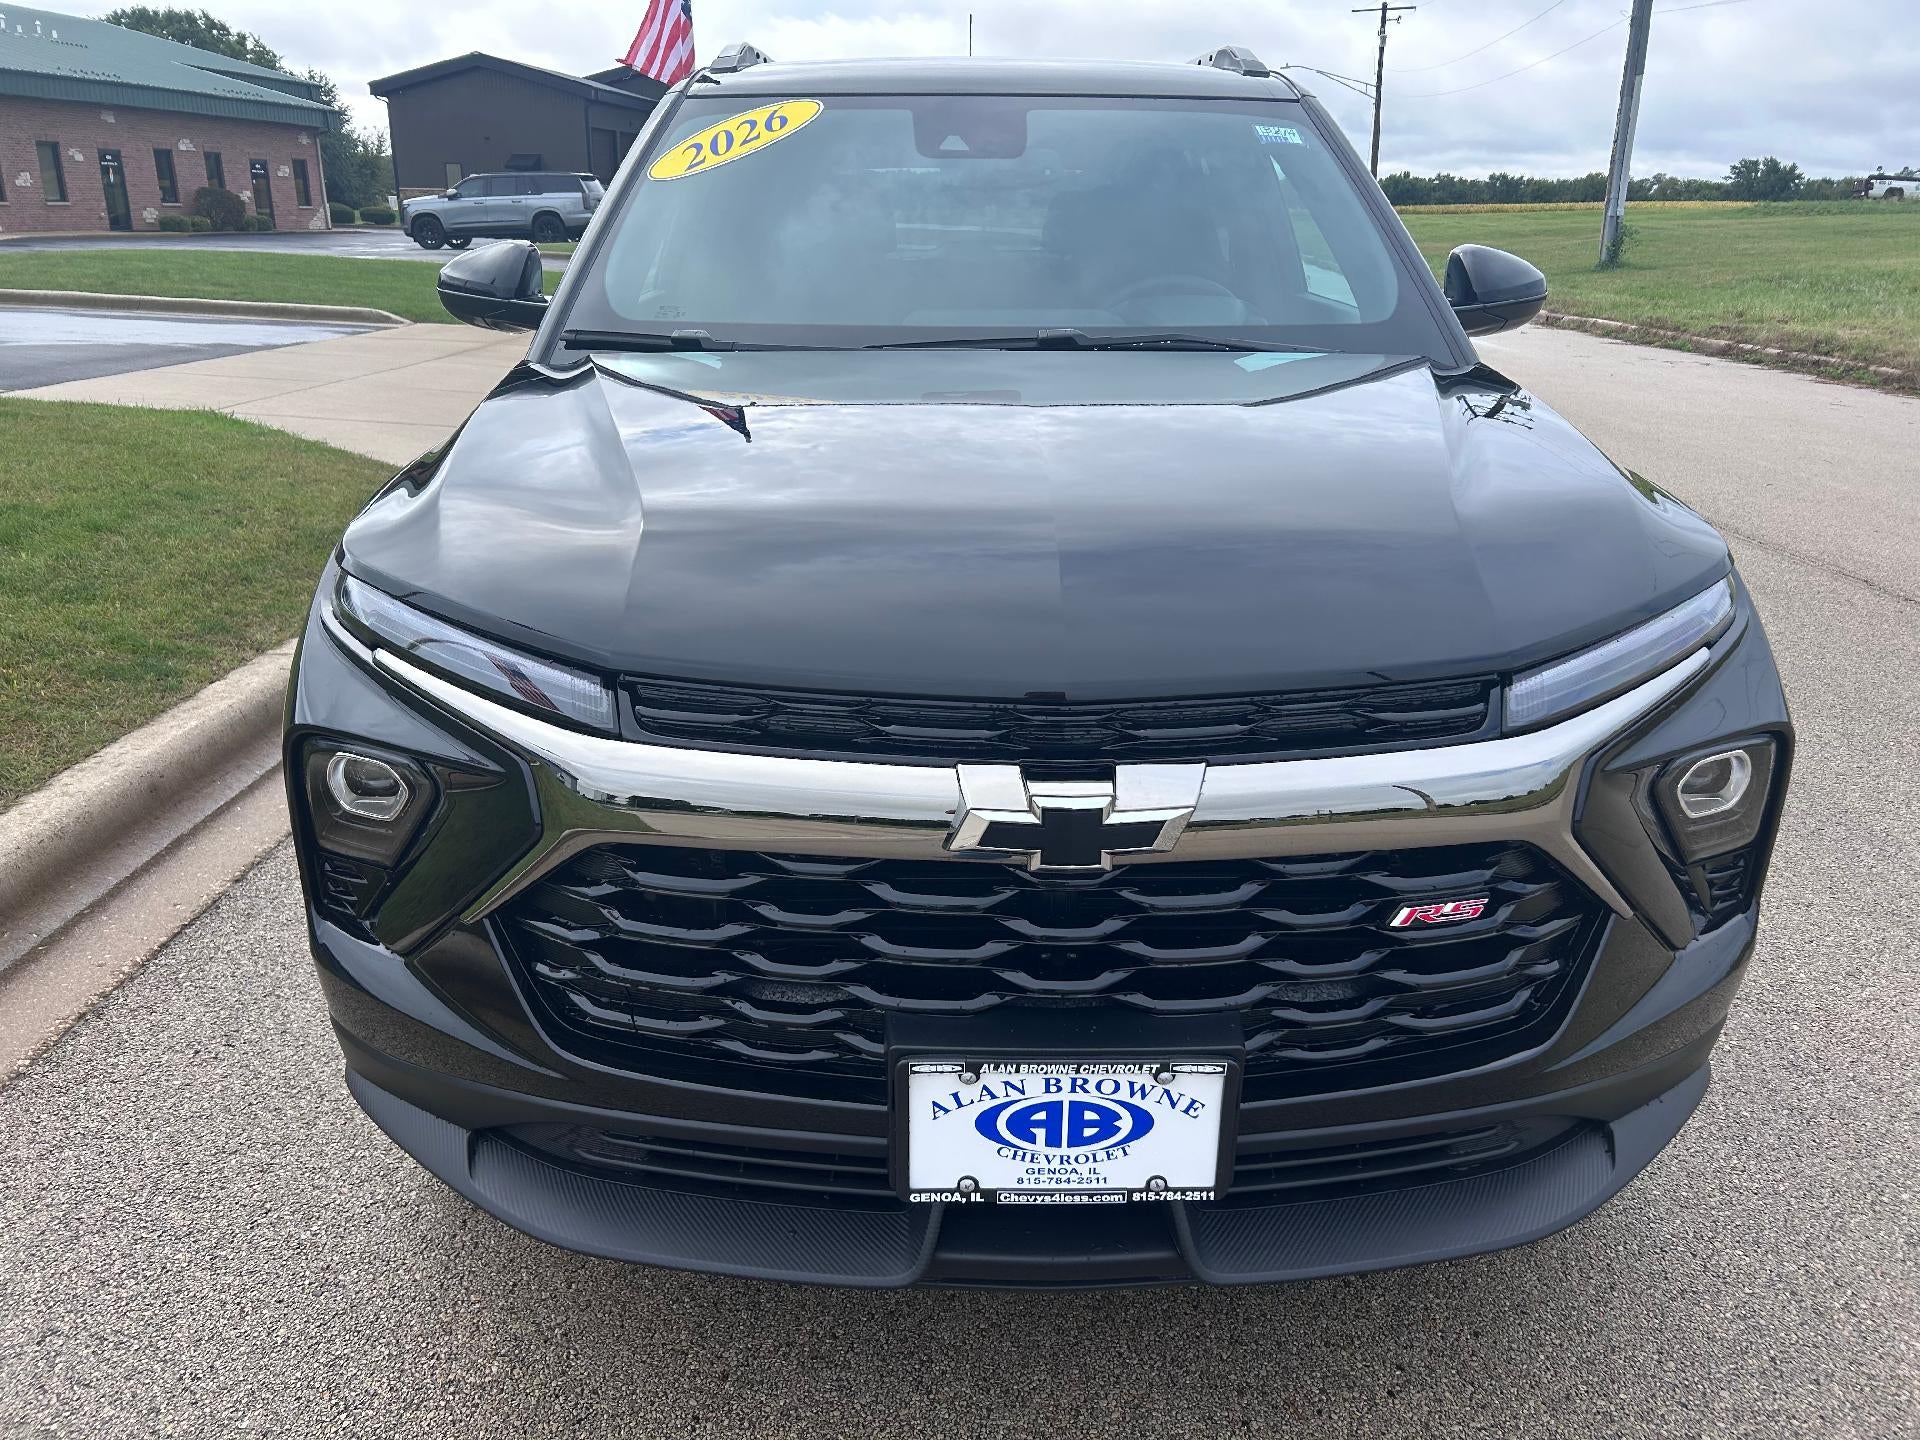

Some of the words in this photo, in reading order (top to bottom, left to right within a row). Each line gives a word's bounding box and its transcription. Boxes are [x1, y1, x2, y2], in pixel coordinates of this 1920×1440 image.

[682, 106, 788, 172] 2026
[1390, 899, 1489, 927] RS
[980, 1063, 1016, 1075] ALAN
[1019, 1064, 1077, 1075] BROWNE
[1079, 1064, 1161, 1075] CHEVROLET
[931, 1078, 1026, 1120] ALAN
[1042, 1076, 1206, 1119] BROWNE
[1003, 1098, 1126, 1150] AB
[996, 1145, 1131, 1166] CHEVROLET
[1025, 1167, 1083, 1176] GENOA,
[1088, 1167, 1101, 1175] IL
[1016, 1176, 1108, 1185] 815-784-2511
[909, 1192, 966, 1204] GENOA,
[970, 1192, 985, 1202] IL
[999, 1192, 1124, 1204] Chevys4less.com
[1132, 1191, 1215, 1201] 815-784-2511
